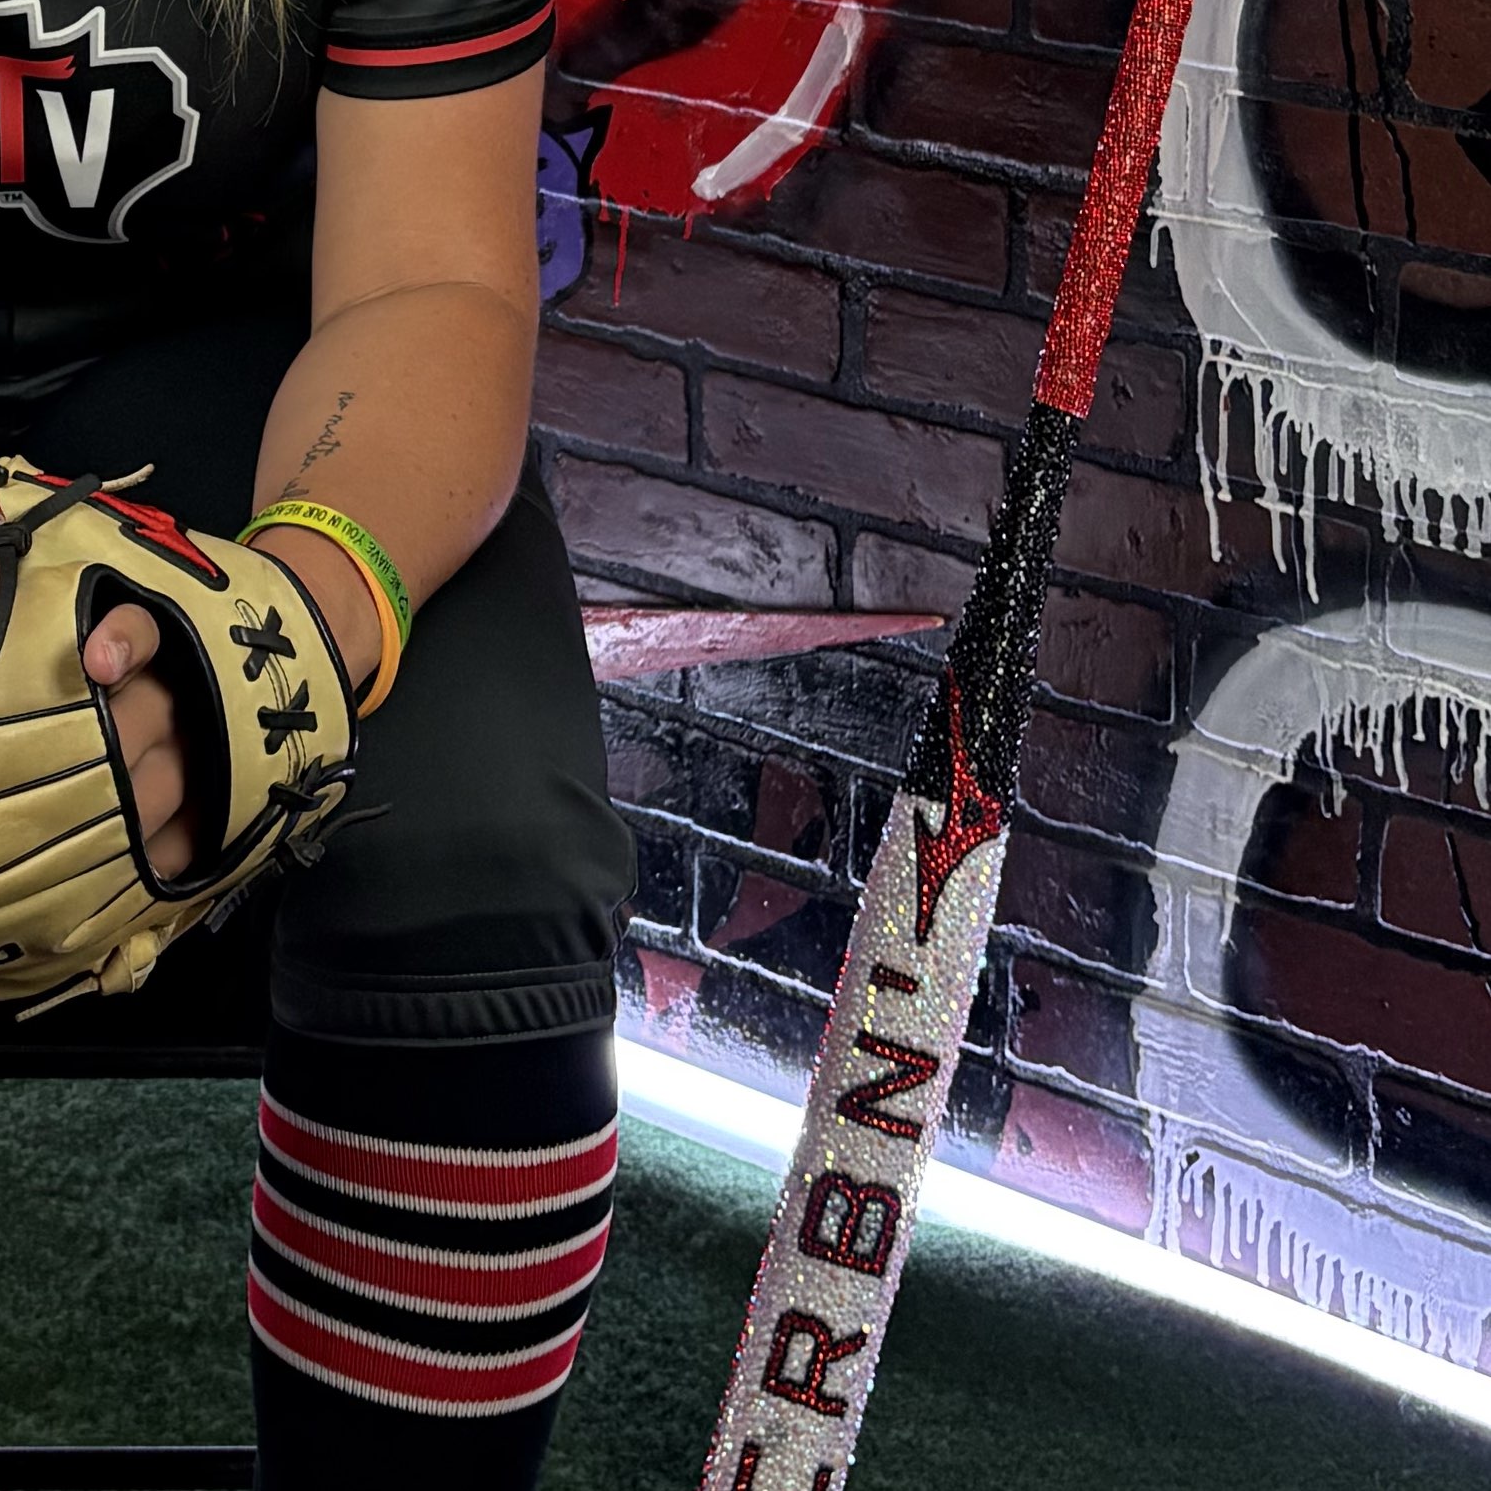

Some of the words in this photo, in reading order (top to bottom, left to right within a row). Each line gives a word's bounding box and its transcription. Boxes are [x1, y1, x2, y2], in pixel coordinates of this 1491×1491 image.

[3, 193, 23, 201] TM
[302, 505, 328, 522] OUR
[342, 522, 366, 546] YOU
[365, 541, 393, 575] HAVE
